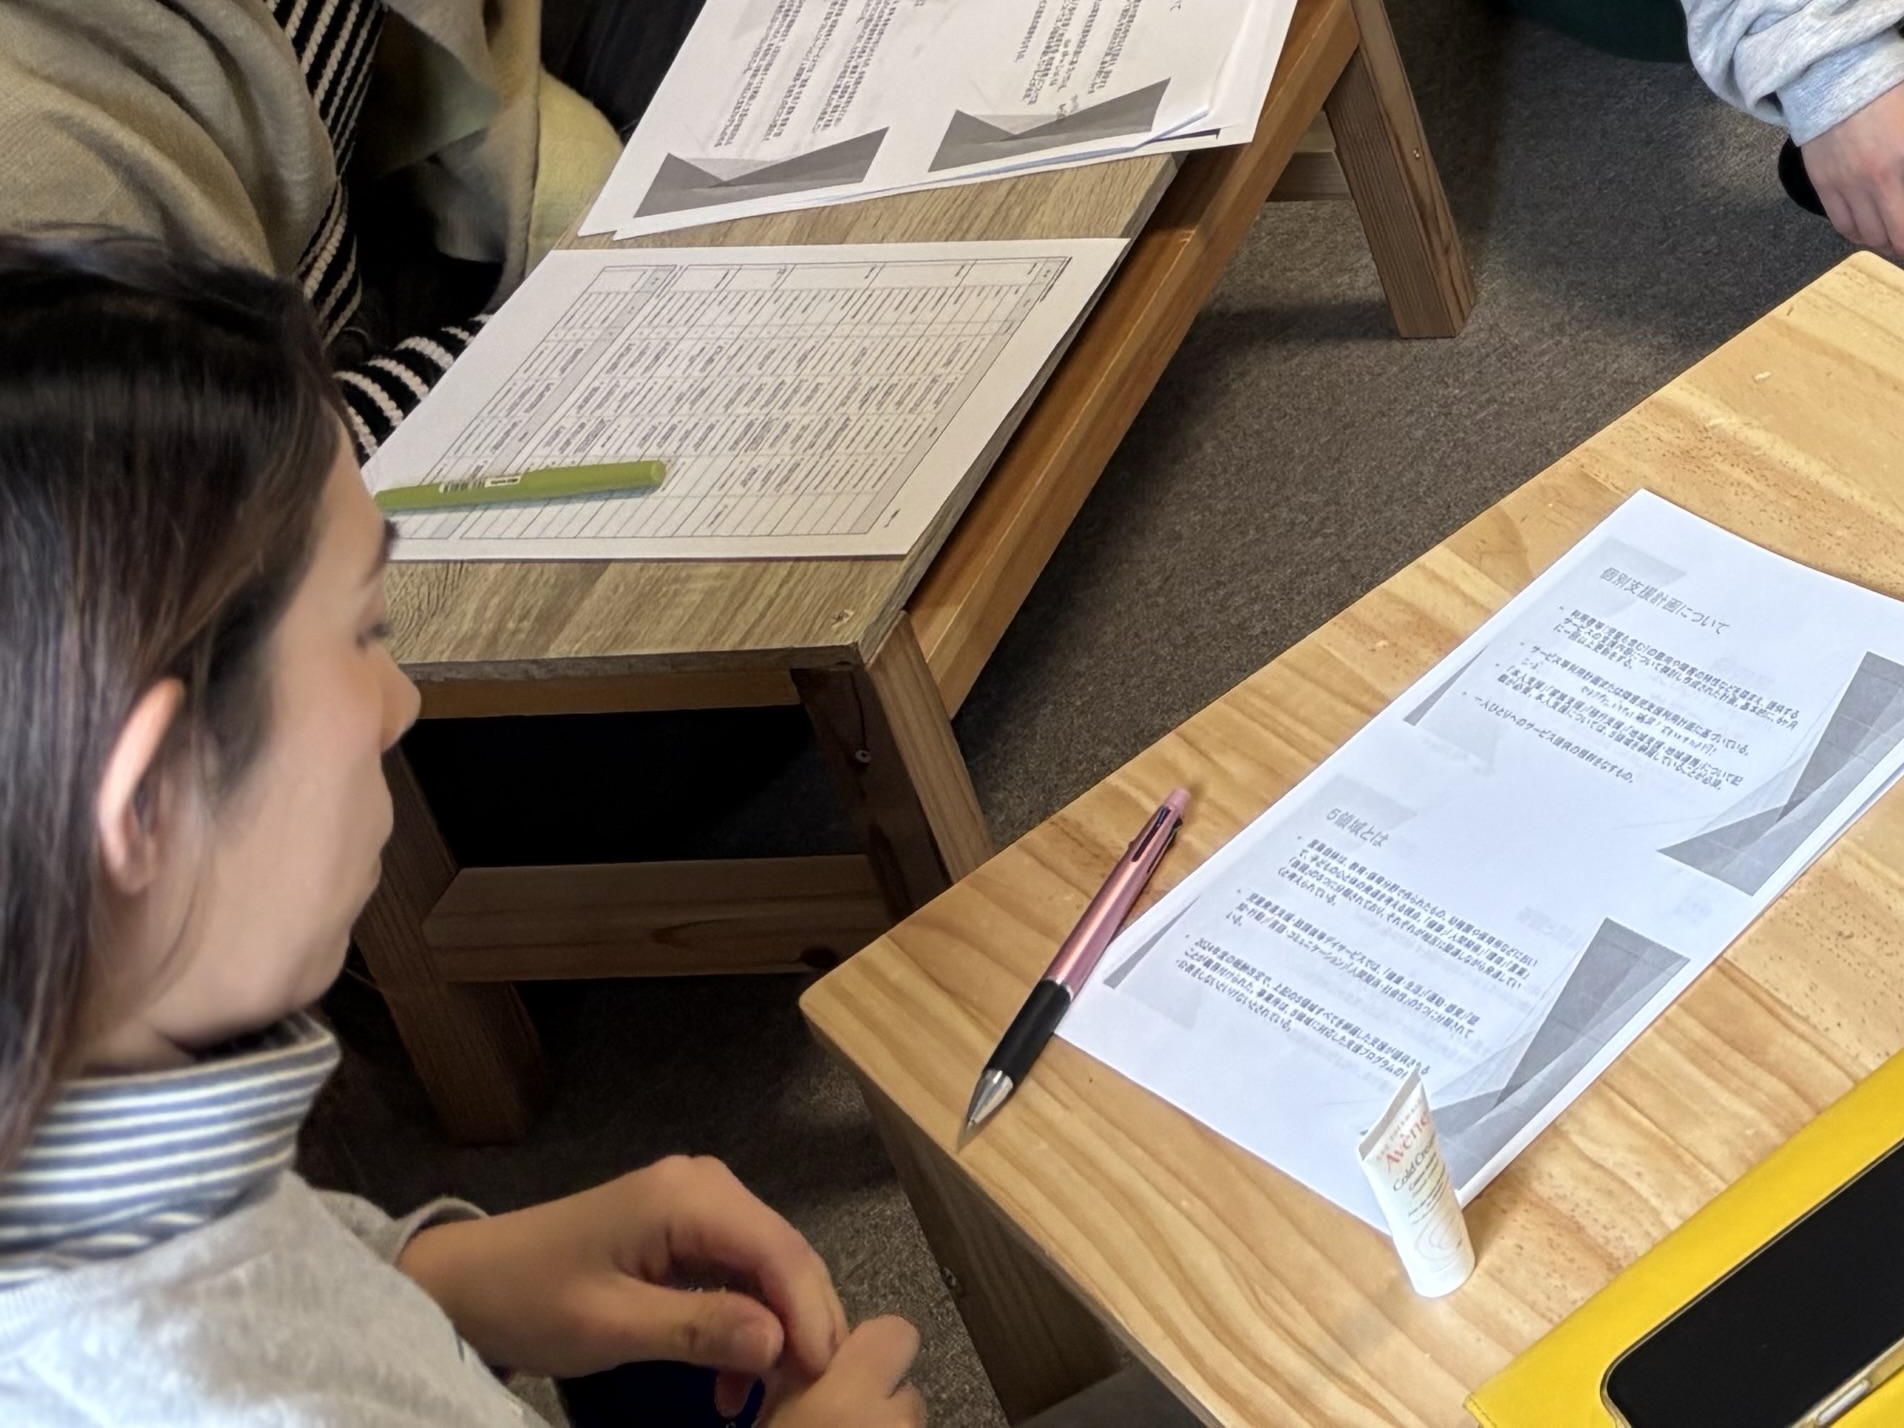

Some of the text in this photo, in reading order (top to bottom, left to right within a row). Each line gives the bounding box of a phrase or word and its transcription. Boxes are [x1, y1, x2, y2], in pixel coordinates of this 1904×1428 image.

[1593, 566, 1733, 636] 個別支援計画について
[1319, 806, 1395, 848] 5領域とは
